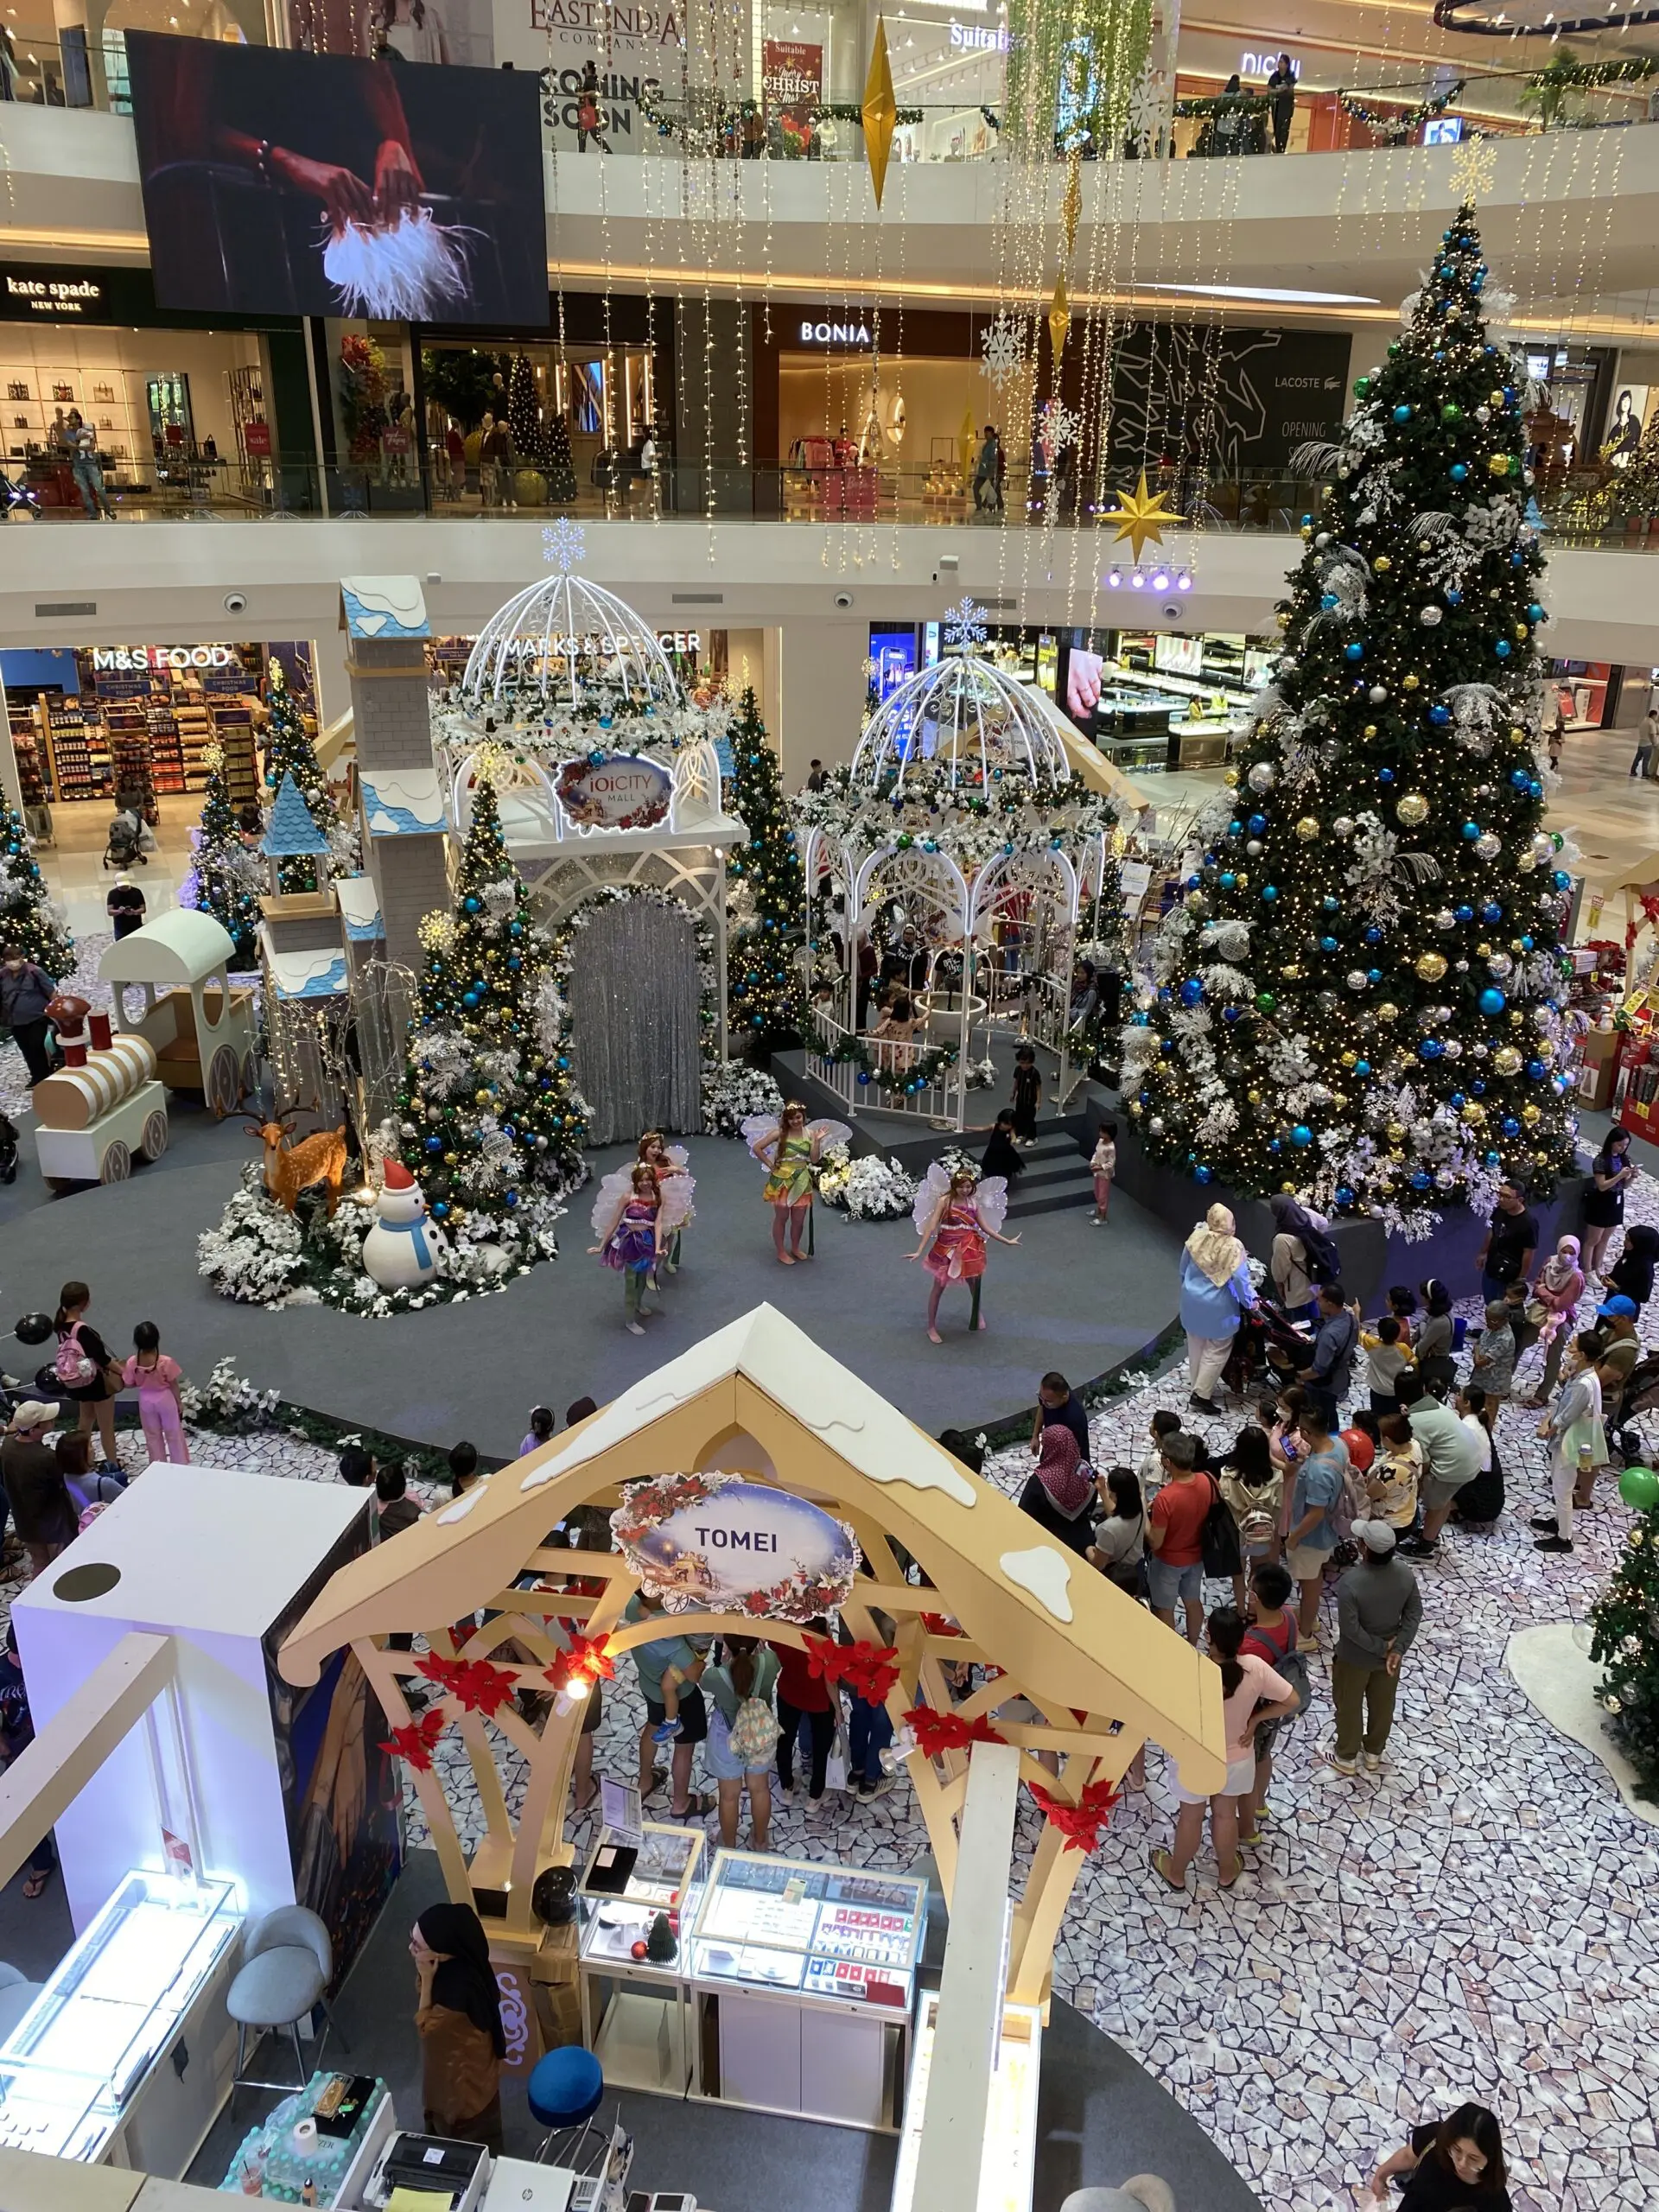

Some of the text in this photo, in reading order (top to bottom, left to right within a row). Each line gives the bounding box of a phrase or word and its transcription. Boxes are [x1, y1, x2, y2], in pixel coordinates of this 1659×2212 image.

[529, 0, 596, 30] EAST
[775, 44, 807, 55] Suitable
[762, 75, 820, 93] CHRIST
[6, 276, 100, 300] kate spade
[31, 301, 82, 312] NEW YORK
[801, 321, 869, 343] BONIA
[1274, 377, 1320, 388] LACOSTE
[1281, 422, 1326, 437] OPENING
[504, 637, 579, 657] MARKS
[92, 646, 230, 671] M&S FOOD
[607, 793, 635, 803] MALL
[695, 1528, 777, 1553] TOMEI
